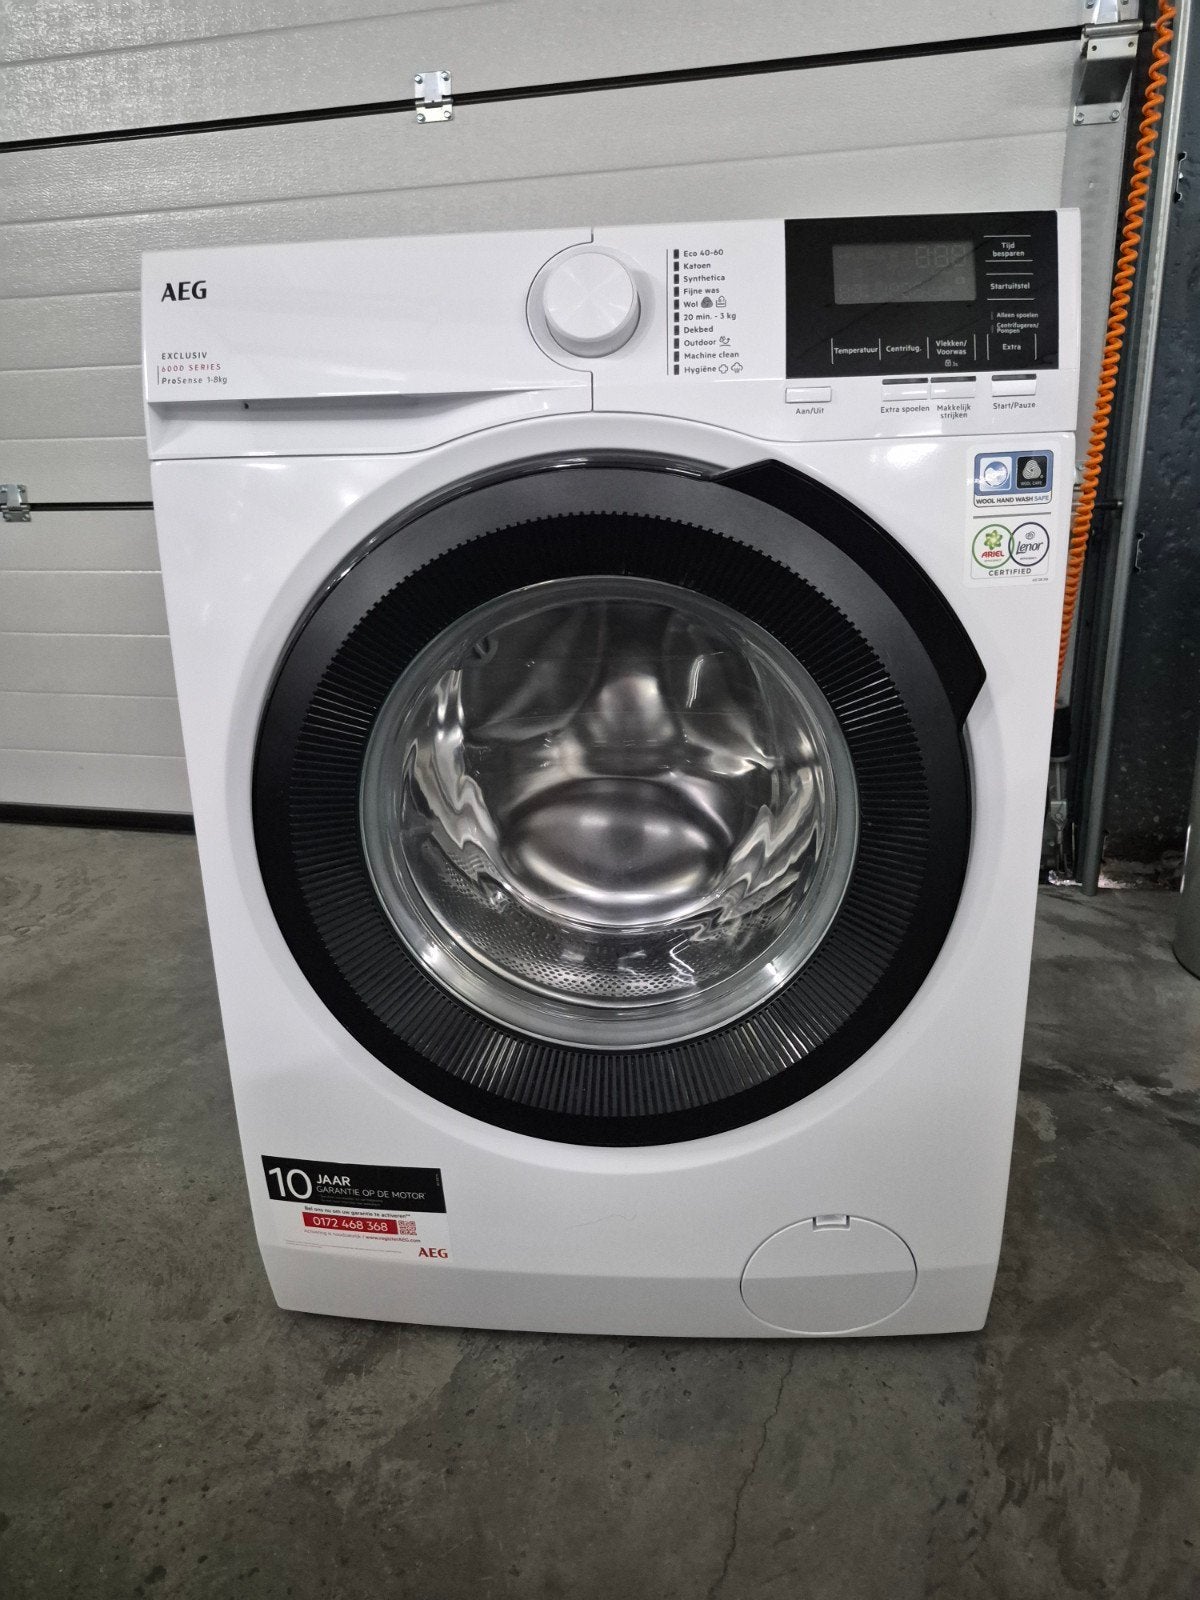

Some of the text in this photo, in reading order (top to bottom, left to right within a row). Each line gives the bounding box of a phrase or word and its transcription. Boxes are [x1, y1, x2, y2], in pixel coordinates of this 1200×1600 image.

[1001, 242, 1015, 250] Tijd
[992, 250, 1025, 259] besparen
[684, 262, 711, 270] Katoen
[684, 275, 725, 283] Synthetica
[990, 282, 1030, 290] Startuitstel
[161, 280, 207, 302] AEG
[684, 288, 702, 296] Fijne
[684, 300, 698, 308] Wol
[726, 312, 737, 320] kg
[684, 326, 714, 334] Dekbed
[996, 322, 1039, 330] Centrifugeren/
[684, 339, 716, 347] Outdoor
[834, 346, 878, 354] Temperatuur
[886, 345, 922, 354] Centrifug.
[161, 352, 208, 360] EXCLUSIV
[684, 352, 716, 360] Machine
[161, 364, 184, 372] 6000
[684, 366, 716, 374] Hygiëne
[162, 376, 228, 385] ProSense 1-8kg
[880, 405, 930, 414] Extra spoelen
[936, 404, 972, 412] Makkelijk
[992, 402, 1036, 410] Start/Pauze
[795, 407, 825, 416] Aan/Uit
[940, 412, 968, 420] strijken
[1016, 541, 1044, 555] Lenor
[982, 550, 1004, 558] ARIEL
[988, 568, 1032, 576] CERTIFIED
[268, 1167, 312, 1200] 10
[316, 1174, 350, 1186] JAAR
[316, 1186, 360, 1196] GARANTIE
[377, 1190, 390, 1198] DE
[312, 1216, 388, 1232] 0172 468 368
[418, 1247, 448, 1259] AEG
